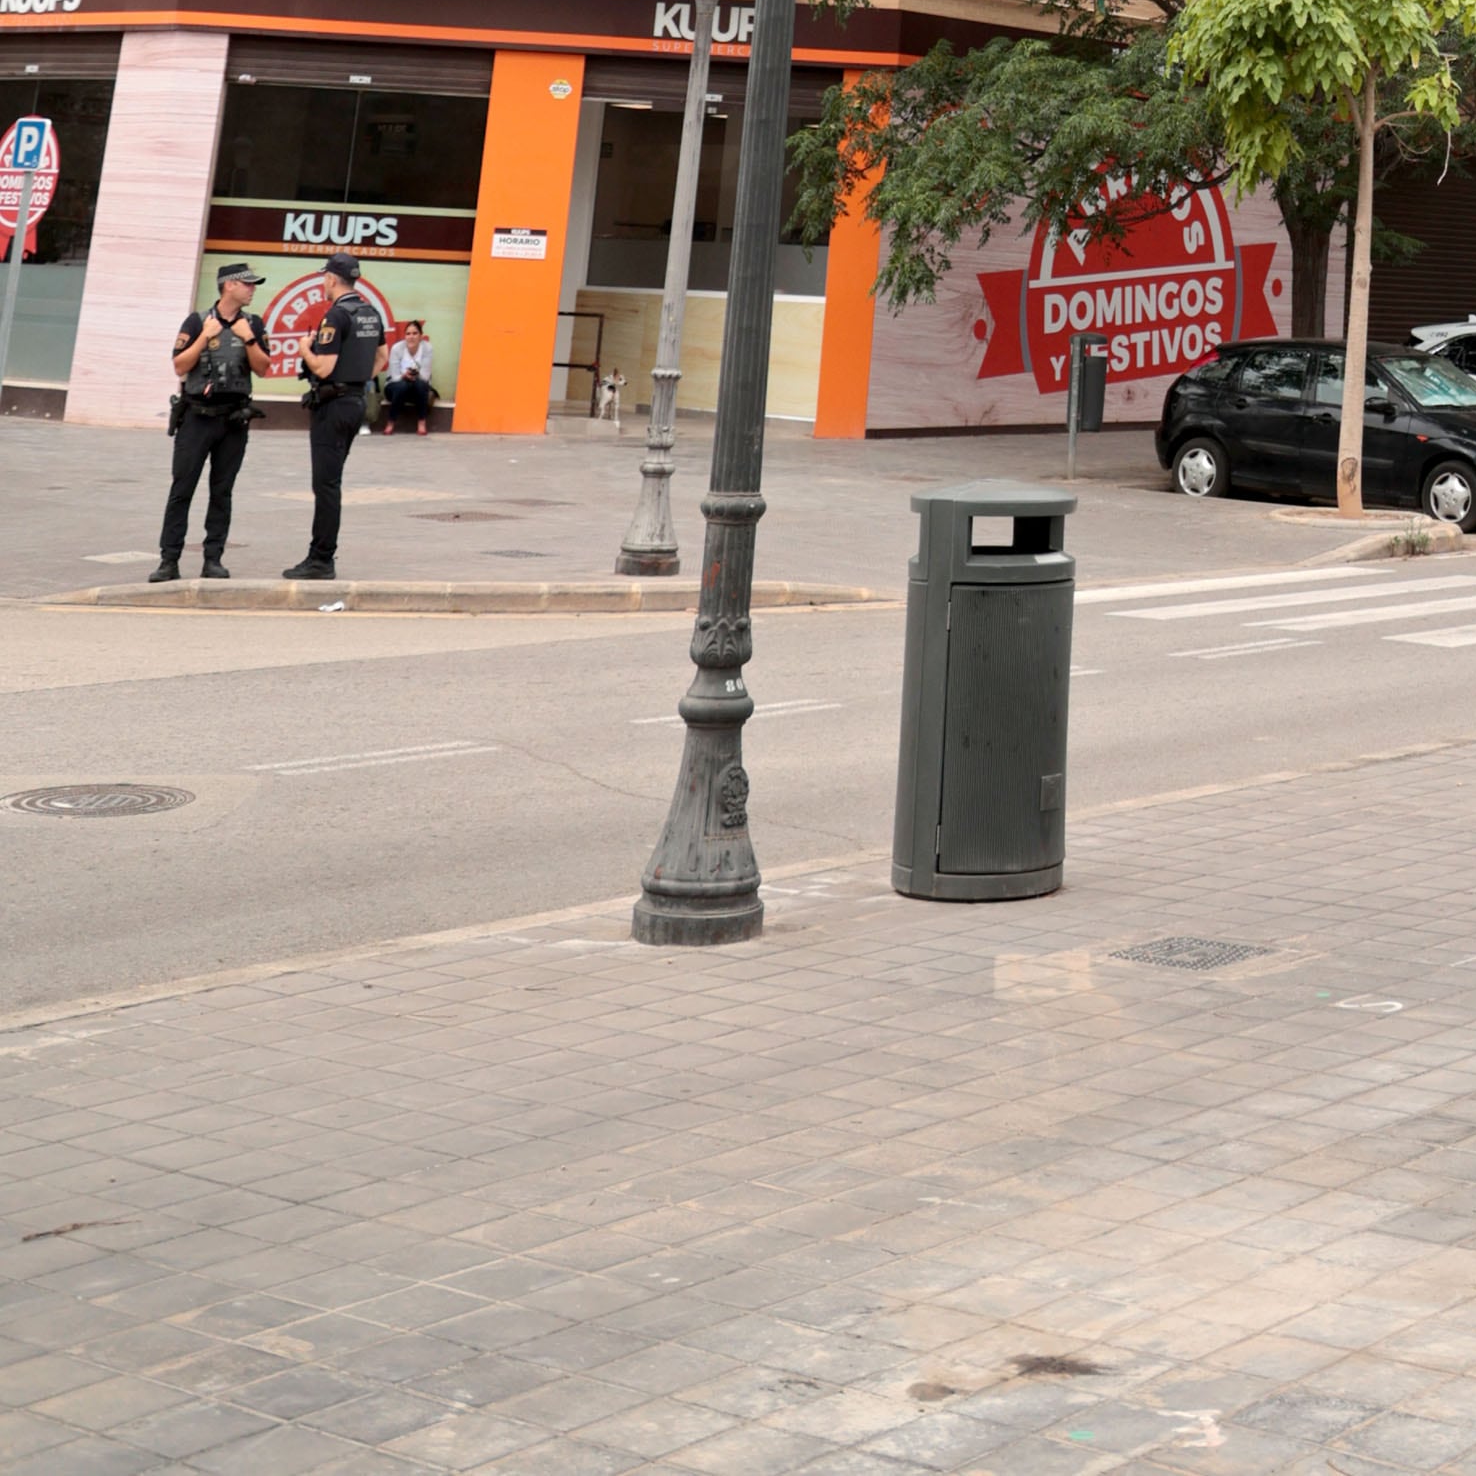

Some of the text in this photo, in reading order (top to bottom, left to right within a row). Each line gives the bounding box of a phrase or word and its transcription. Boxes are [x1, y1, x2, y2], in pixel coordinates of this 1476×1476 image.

[653, 2, 756, 42] KUUP
[17, 126, 39, 164] P
[283, 212, 398, 246] KUUPS
[499, 237, 541, 246] HORARIO
[1043, 277, 1224, 335] DOMINGOS
[1051, 355, 1066, 381] Y
